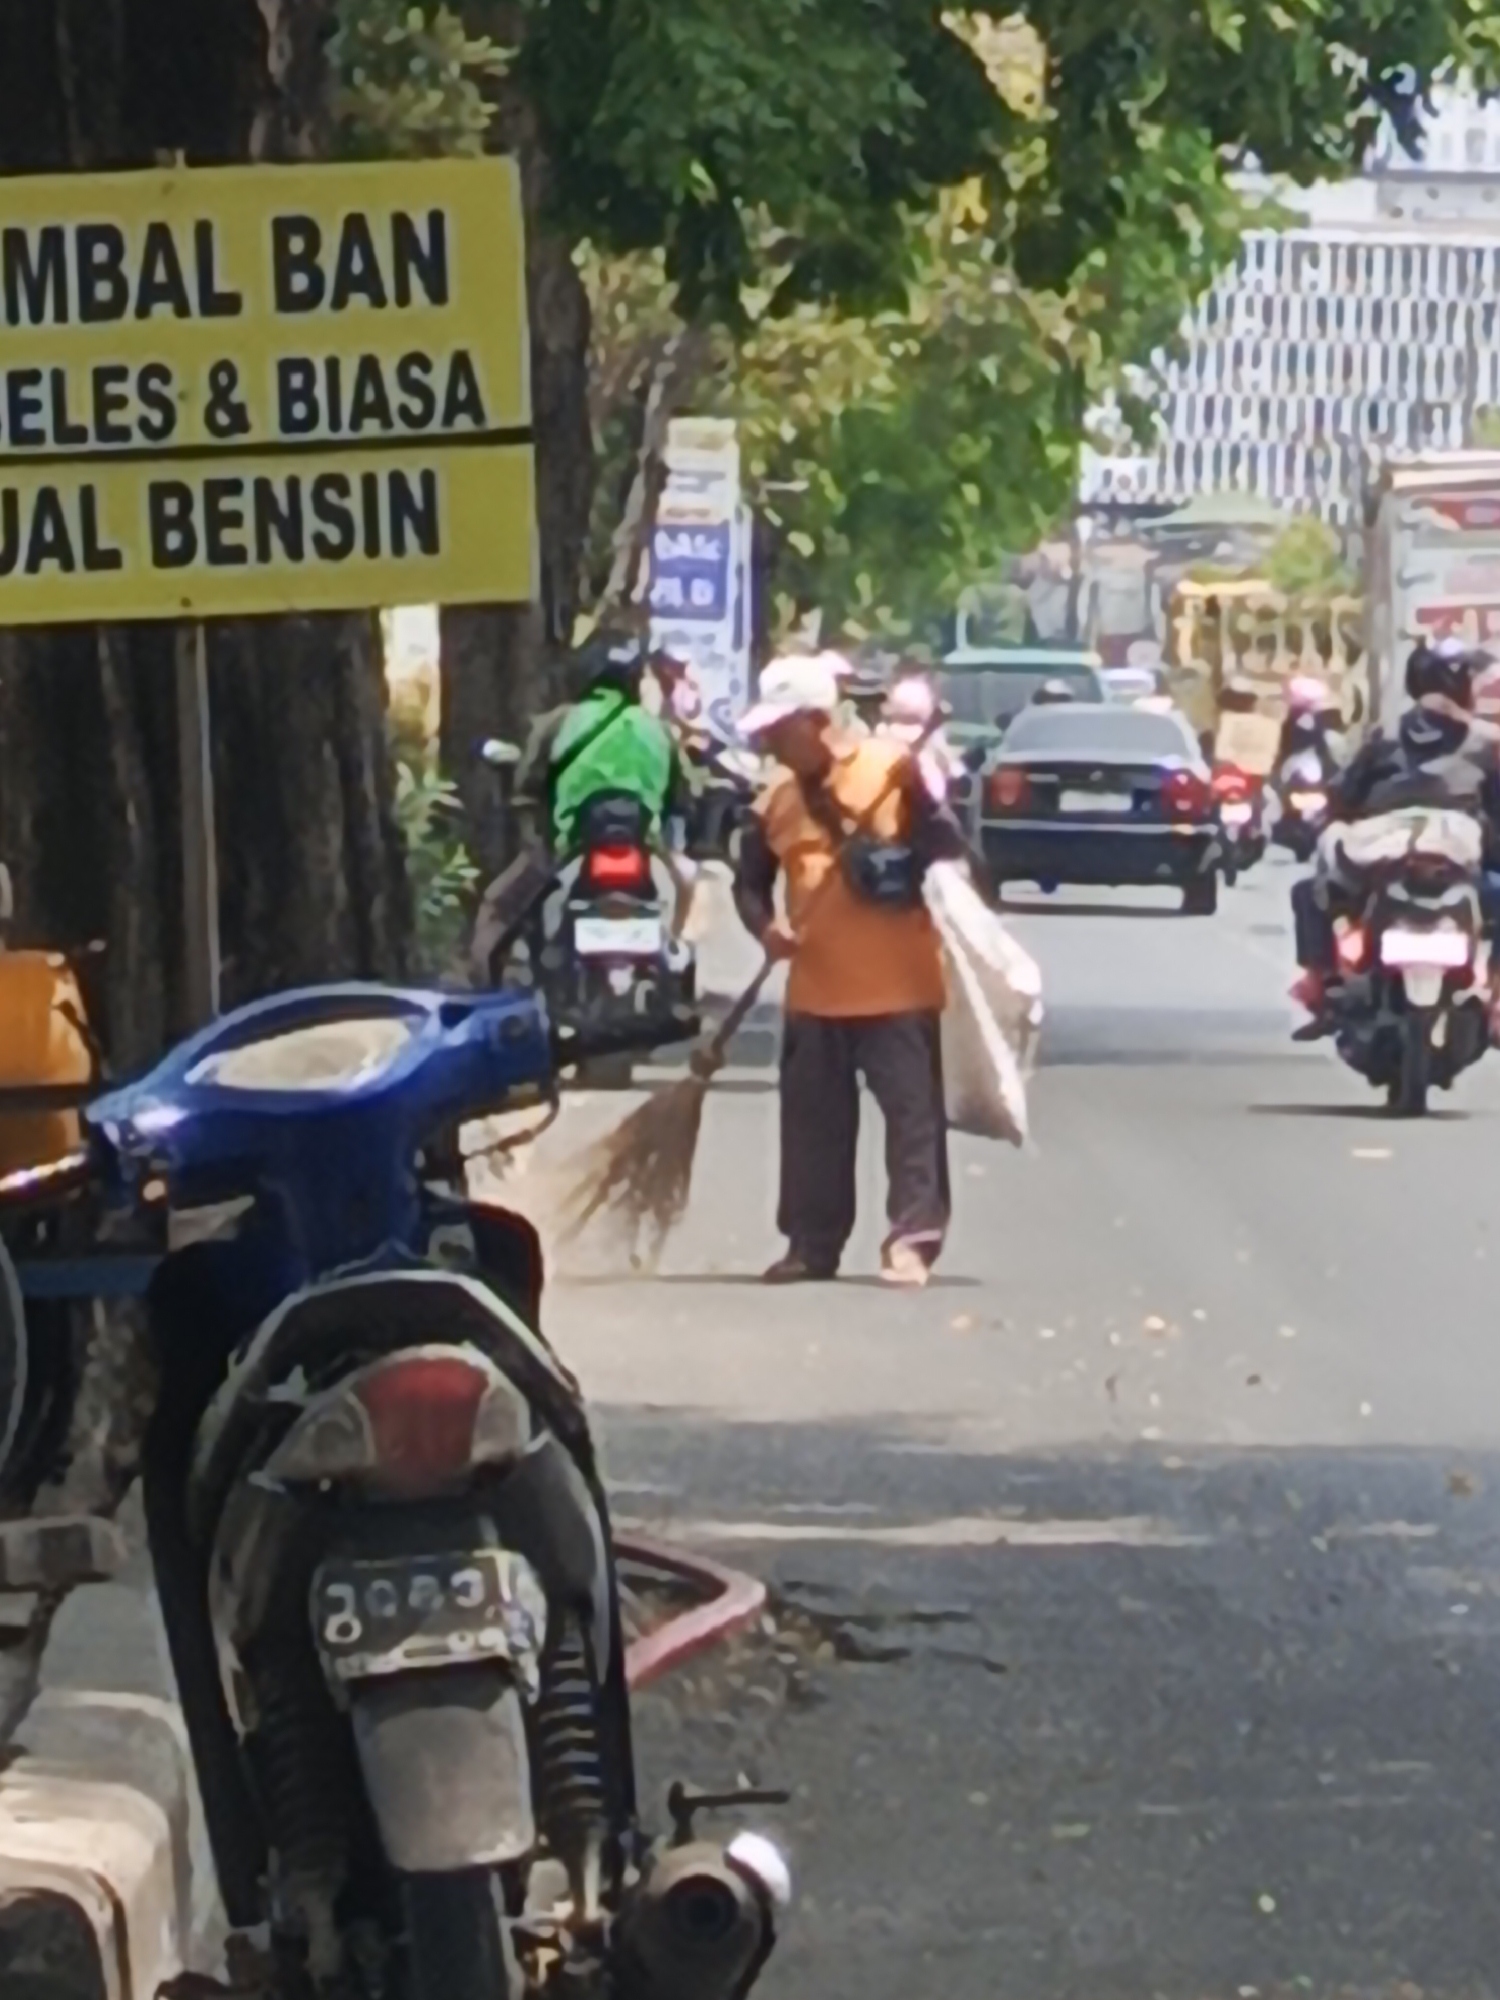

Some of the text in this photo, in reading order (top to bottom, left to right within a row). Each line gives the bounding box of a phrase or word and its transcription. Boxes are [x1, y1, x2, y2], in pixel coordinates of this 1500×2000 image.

[2, 208, 450, 326] MBAL BAN
[0, 349, 487, 447] ELES & BIASA
[148, 468, 440, 569] BENSIN
